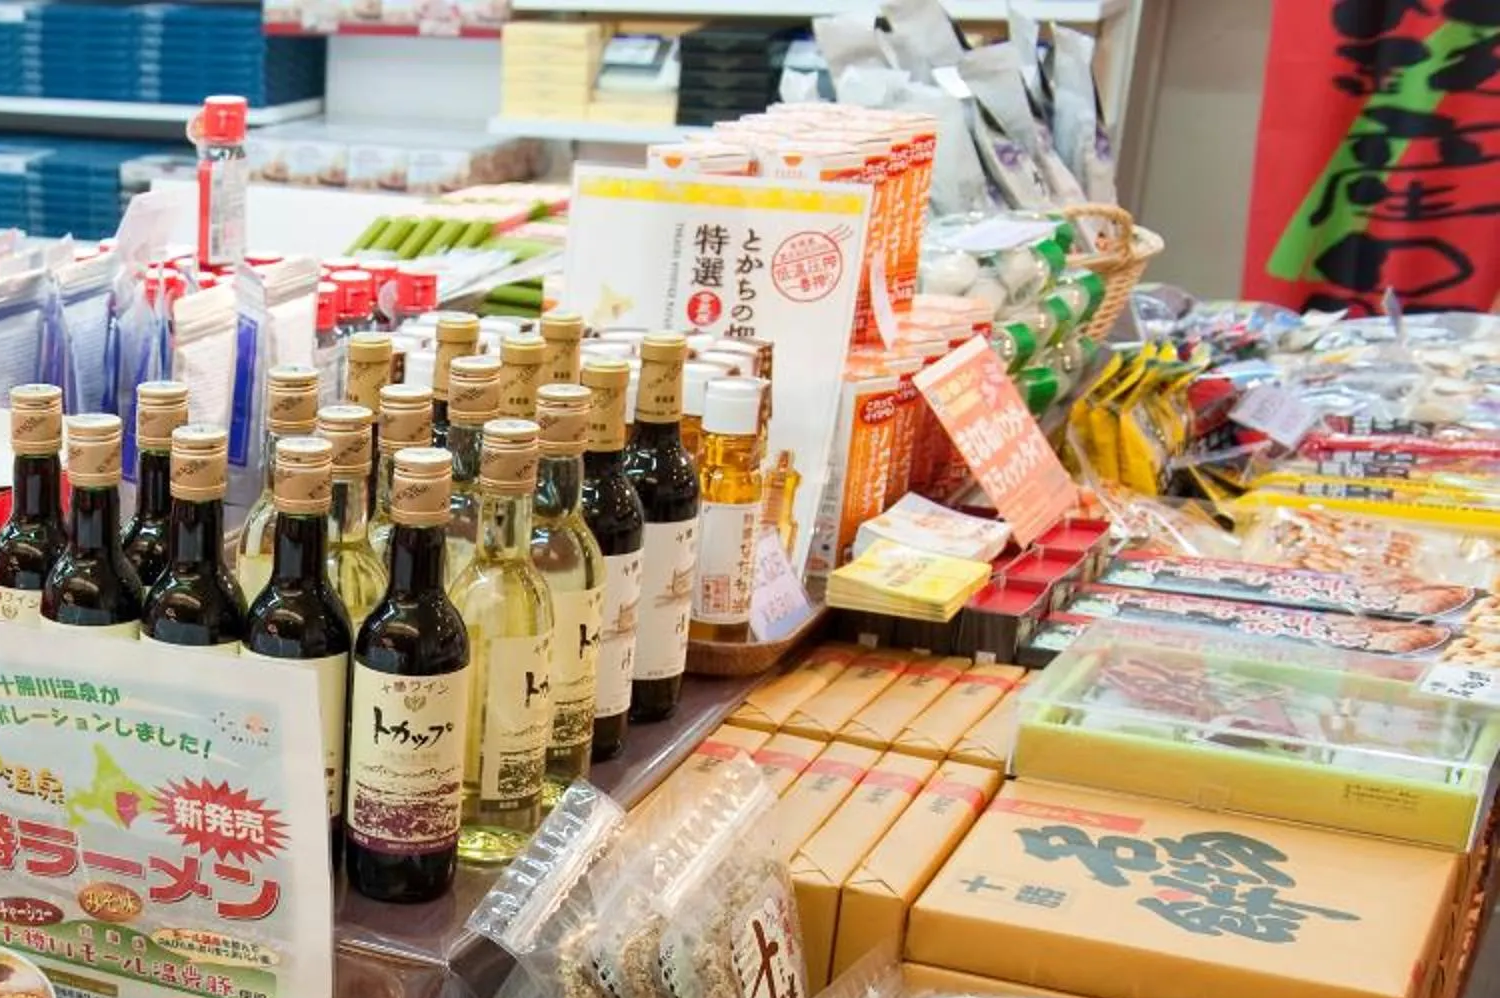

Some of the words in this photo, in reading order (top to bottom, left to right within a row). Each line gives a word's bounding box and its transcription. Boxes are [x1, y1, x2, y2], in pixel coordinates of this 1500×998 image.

[693, 223, 730, 288] 特選
[173, 797, 266, 846] 新発売
